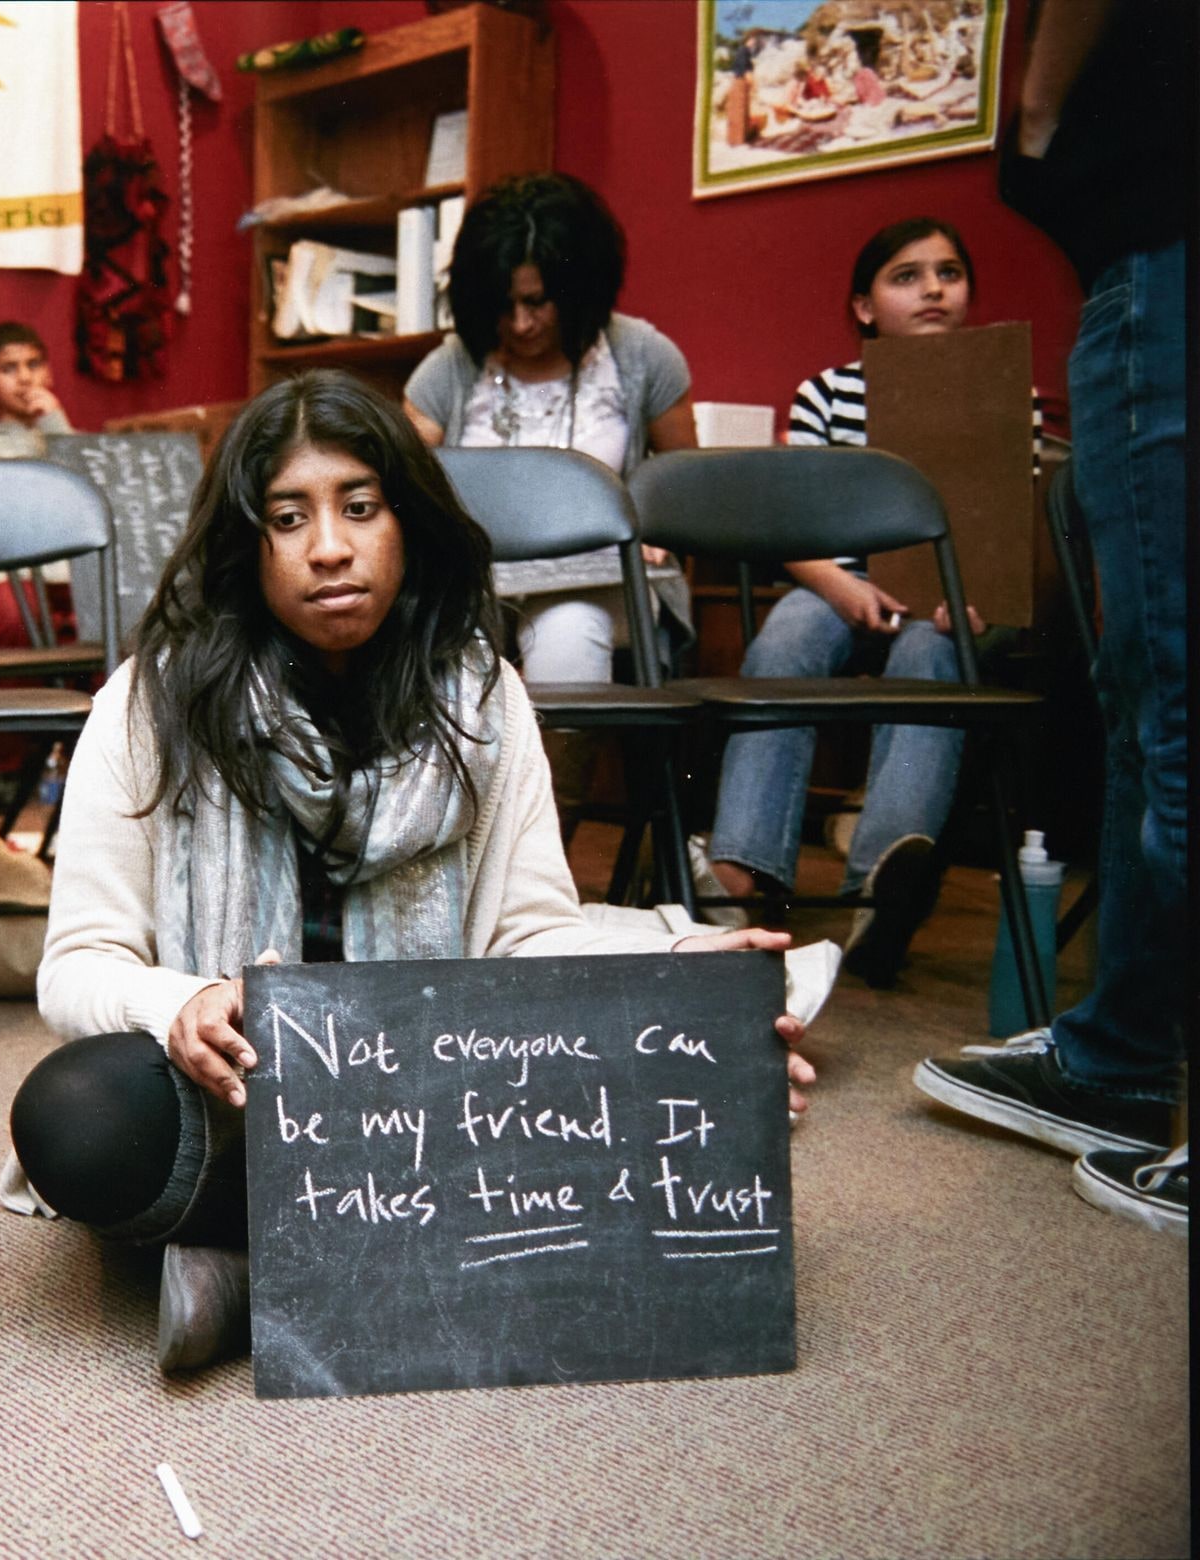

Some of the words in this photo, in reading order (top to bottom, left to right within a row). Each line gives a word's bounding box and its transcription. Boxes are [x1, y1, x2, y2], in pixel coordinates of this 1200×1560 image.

[268, 1004, 400, 1082] Not
[433, 1028, 600, 1087] everyone
[635, 1025, 717, 1063] can
[277, 1096, 328, 1144] be
[362, 1109, 426, 1171] my
[457, 1086, 627, 1147] friend.
[656, 1099, 715, 1147] It
[296, 1167, 436, 1226] takes
[469, 1167, 583, 1214] time
[651, 1155, 772, 1225] trust
